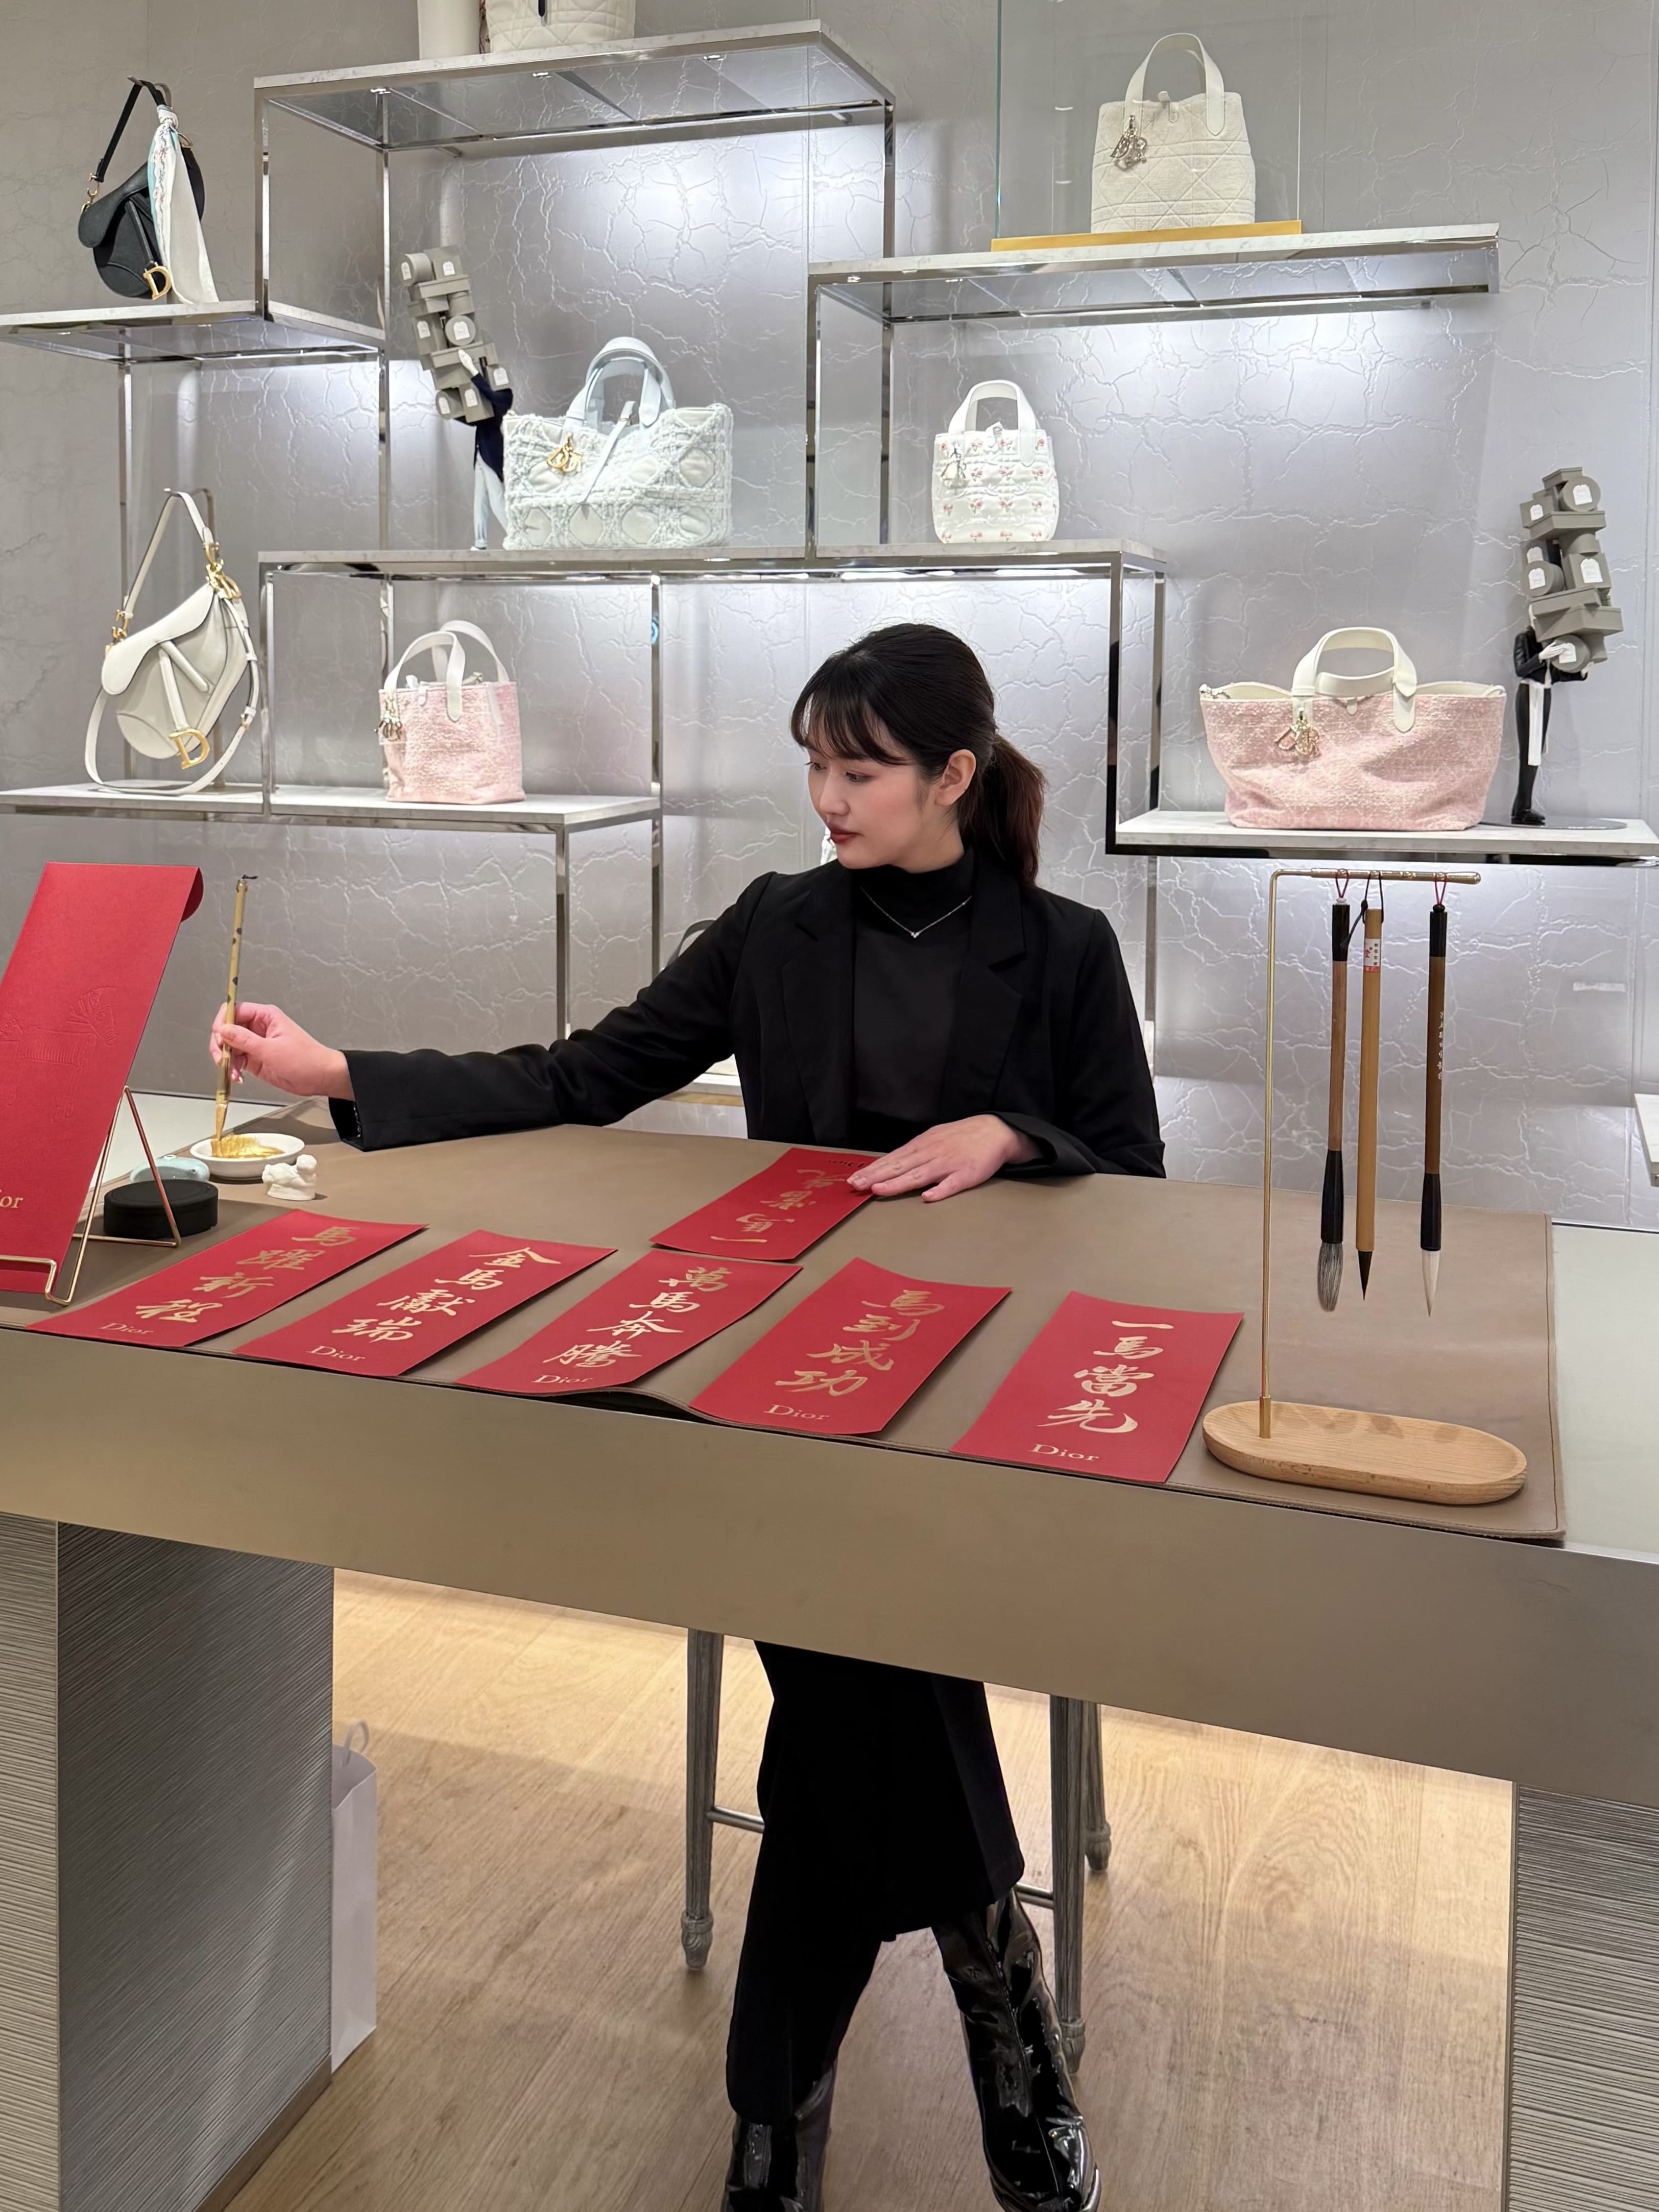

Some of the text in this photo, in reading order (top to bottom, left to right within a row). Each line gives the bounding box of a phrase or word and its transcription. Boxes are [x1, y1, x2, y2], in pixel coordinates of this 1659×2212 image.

[0, 1189, 24, 1208] or
[543, 1266, 733, 1369] 萬馬奔騰
[98, 1321, 155, 1335] Dior
[774, 1289, 945, 1398] 馬到成功
[307, 1345, 366, 1363] Dior
[531, 1374, 594, 1385] Dior
[1037, 1320, 1174, 1433] 一馬當先
[763, 1403, 830, 1421] Dior
[1030, 1443, 1100, 1463] Dior
